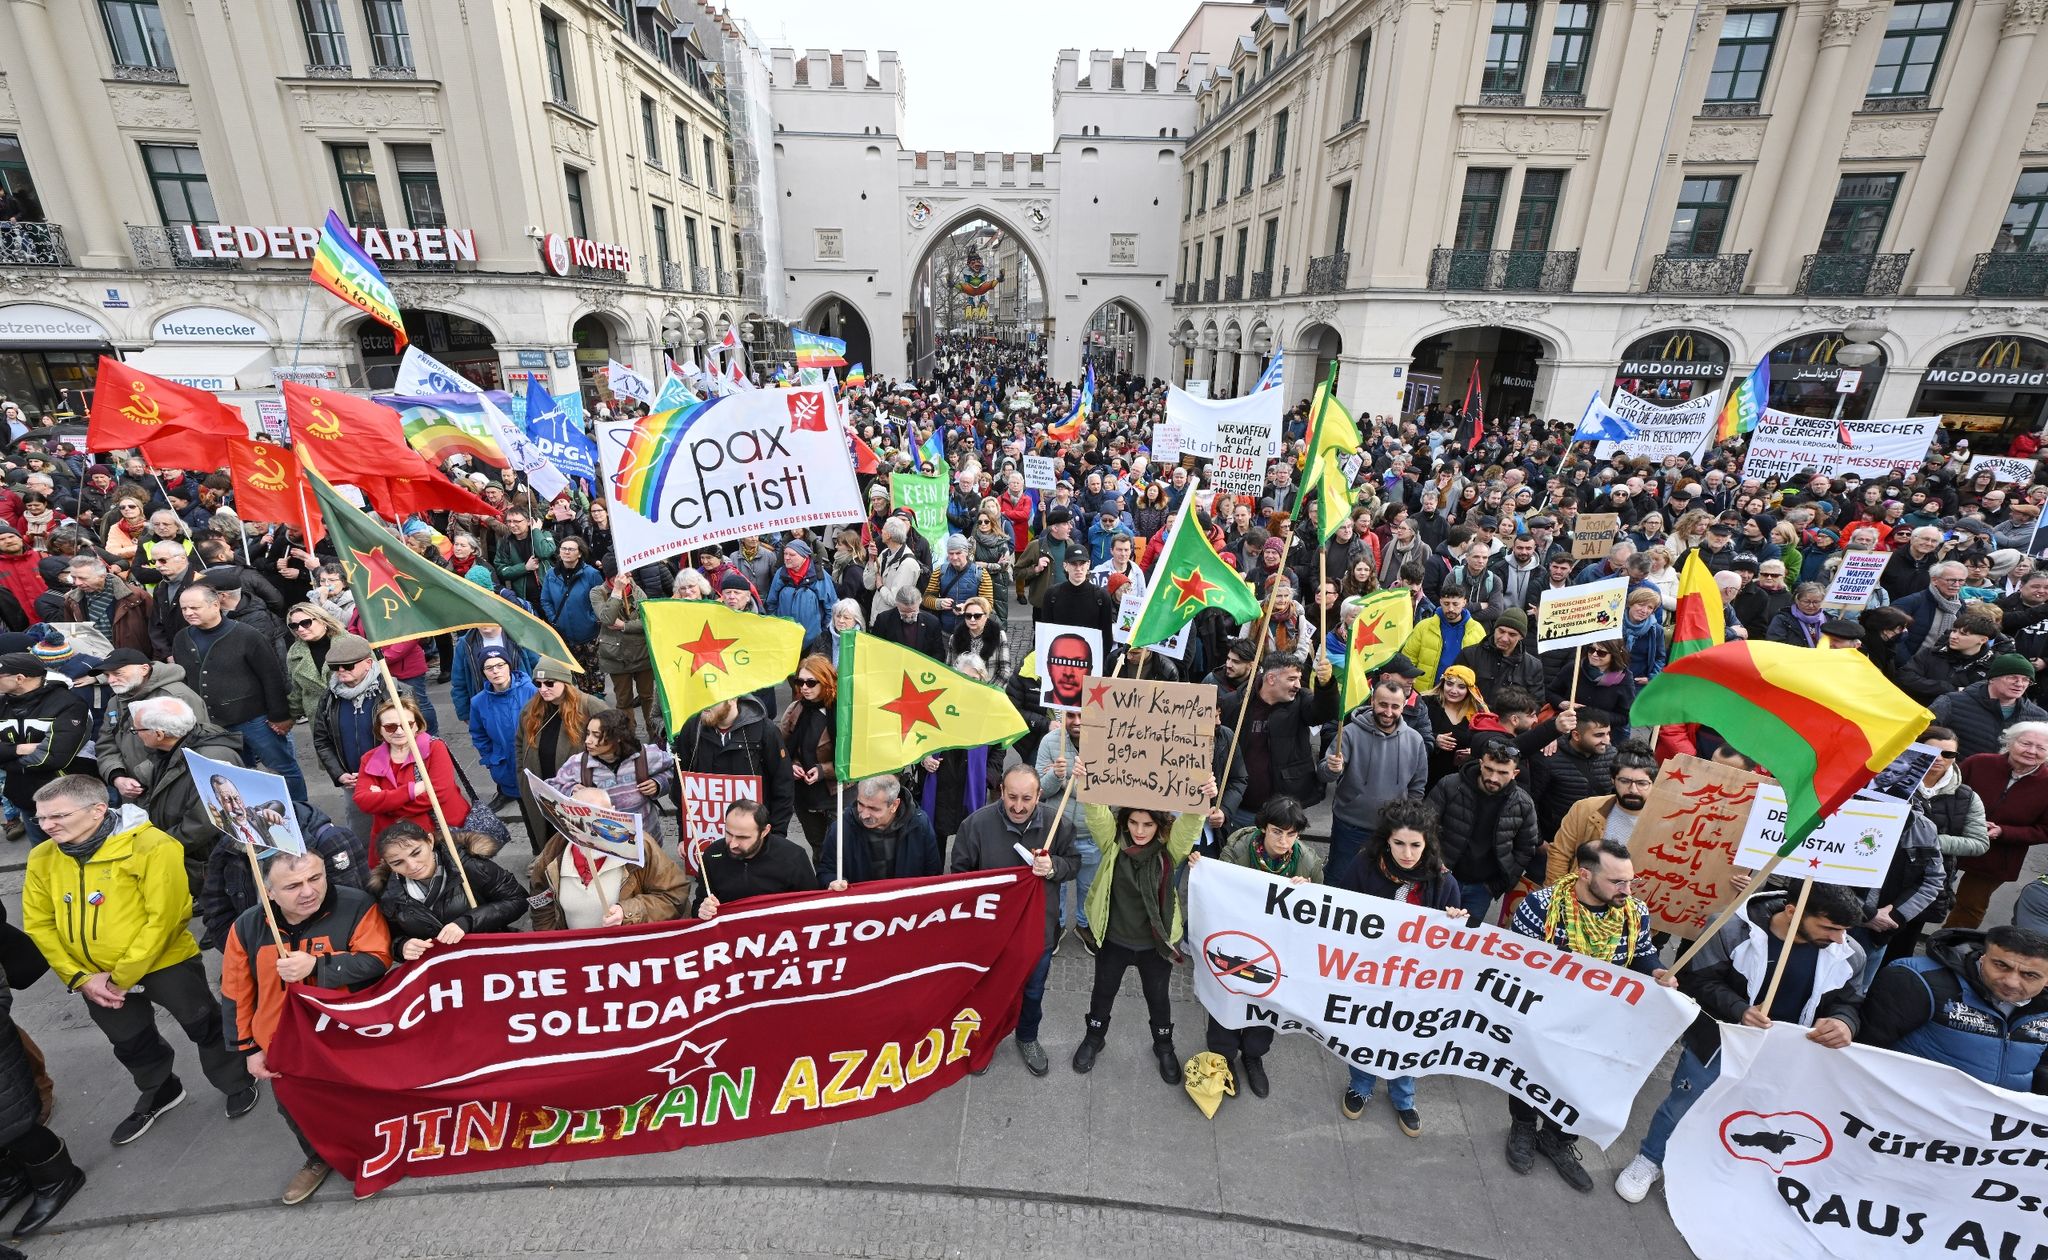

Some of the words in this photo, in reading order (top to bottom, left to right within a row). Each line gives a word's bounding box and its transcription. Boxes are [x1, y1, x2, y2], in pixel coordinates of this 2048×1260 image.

[183, 225, 480, 262] LEDERAREN
[569, 237, 632, 272] KOFFER
[0, 322, 92, 334] etzenecker
[162, 323, 256, 336] Hetzenecker
[1623, 363, 1724, 376] McDonald's
[1927, 370, 2048, 386] McDonald'
[1502, 376, 1535, 389] McDona
[1636, 411, 1654, 425] DIE
[1651, 412, 1707, 426] BUNDESWEHR
[1760, 414, 1791, 427] ALLE
[1794, 418, 1925, 435] KRIEGSVERBRECHER
[1217, 424, 1235, 433] WER
[1236, 424, 1271, 439] WAFFEN
[1224, 436, 1253, 446] kauft
[1757, 426, 1779, 434] VOR
[1781, 427, 1834, 439] GERICHT!
[688, 425, 792, 477] pax
[1216, 444, 1231, 454] hat
[1236, 444, 1261, 457] bald
[1751, 447, 1789, 459] DONT
[1791, 452, 1818, 463] KILL
[1822, 454, 1843, 465] THE
[1844, 457, 1922, 471] MESSENGER
[1748, 458, 1801, 472] FREIHEIT
[250, 479, 289, 492] MLKP
[1213, 470, 1227, 478] an
[1228, 470, 1262, 482] seinen
[670, 464, 812, 530] christi
[903, 484, 938, 505] KEIN
[915, 505, 937, 528] FÜR
[623, 535, 701, 566] INTERNATIONALE
[702, 521, 766, 541] KATHOLISCHE
[768, 509, 859, 528] FRIEDENSBEWEGUNG
[1836, 576, 1876, 586] STILLSTAND
[1846, 569, 1875, 578] WAFFEN
[1838, 584, 1868, 593] SOFORT!
[1550, 598, 1587, 609] TÜRKISCHER
[1051, 657, 1089, 668] TERRORIST
[1112, 688, 1145, 709] Wir
[1149, 687, 1213, 720] Kämpfen
[1107, 718, 1206, 748] International,
[1107, 743, 1147, 765] gegen
[1161, 745, 1206, 770] Kapital
[685, 776, 757, 801] NEIN
[560, 803, 592, 817] STOP
[482, 967, 567, 1003] DIE
[581, 892, 1002, 994] INTERNATIONALE
[1264, 882, 1386, 940] Keine
[1397, 914, 1648, 1008] deutschen
[1316, 943, 1465, 992] Waffen
[1474, 967, 1545, 1017] für
[507, 956, 848, 1044] SOLIDARITÄT!
[1322, 993, 1514, 1045] Erdogans
[1244, 1003, 1582, 1128] Machenschaften
[361, 1100, 512, 1179] JIN
[1777, 1176, 1928, 1245] RAUS
